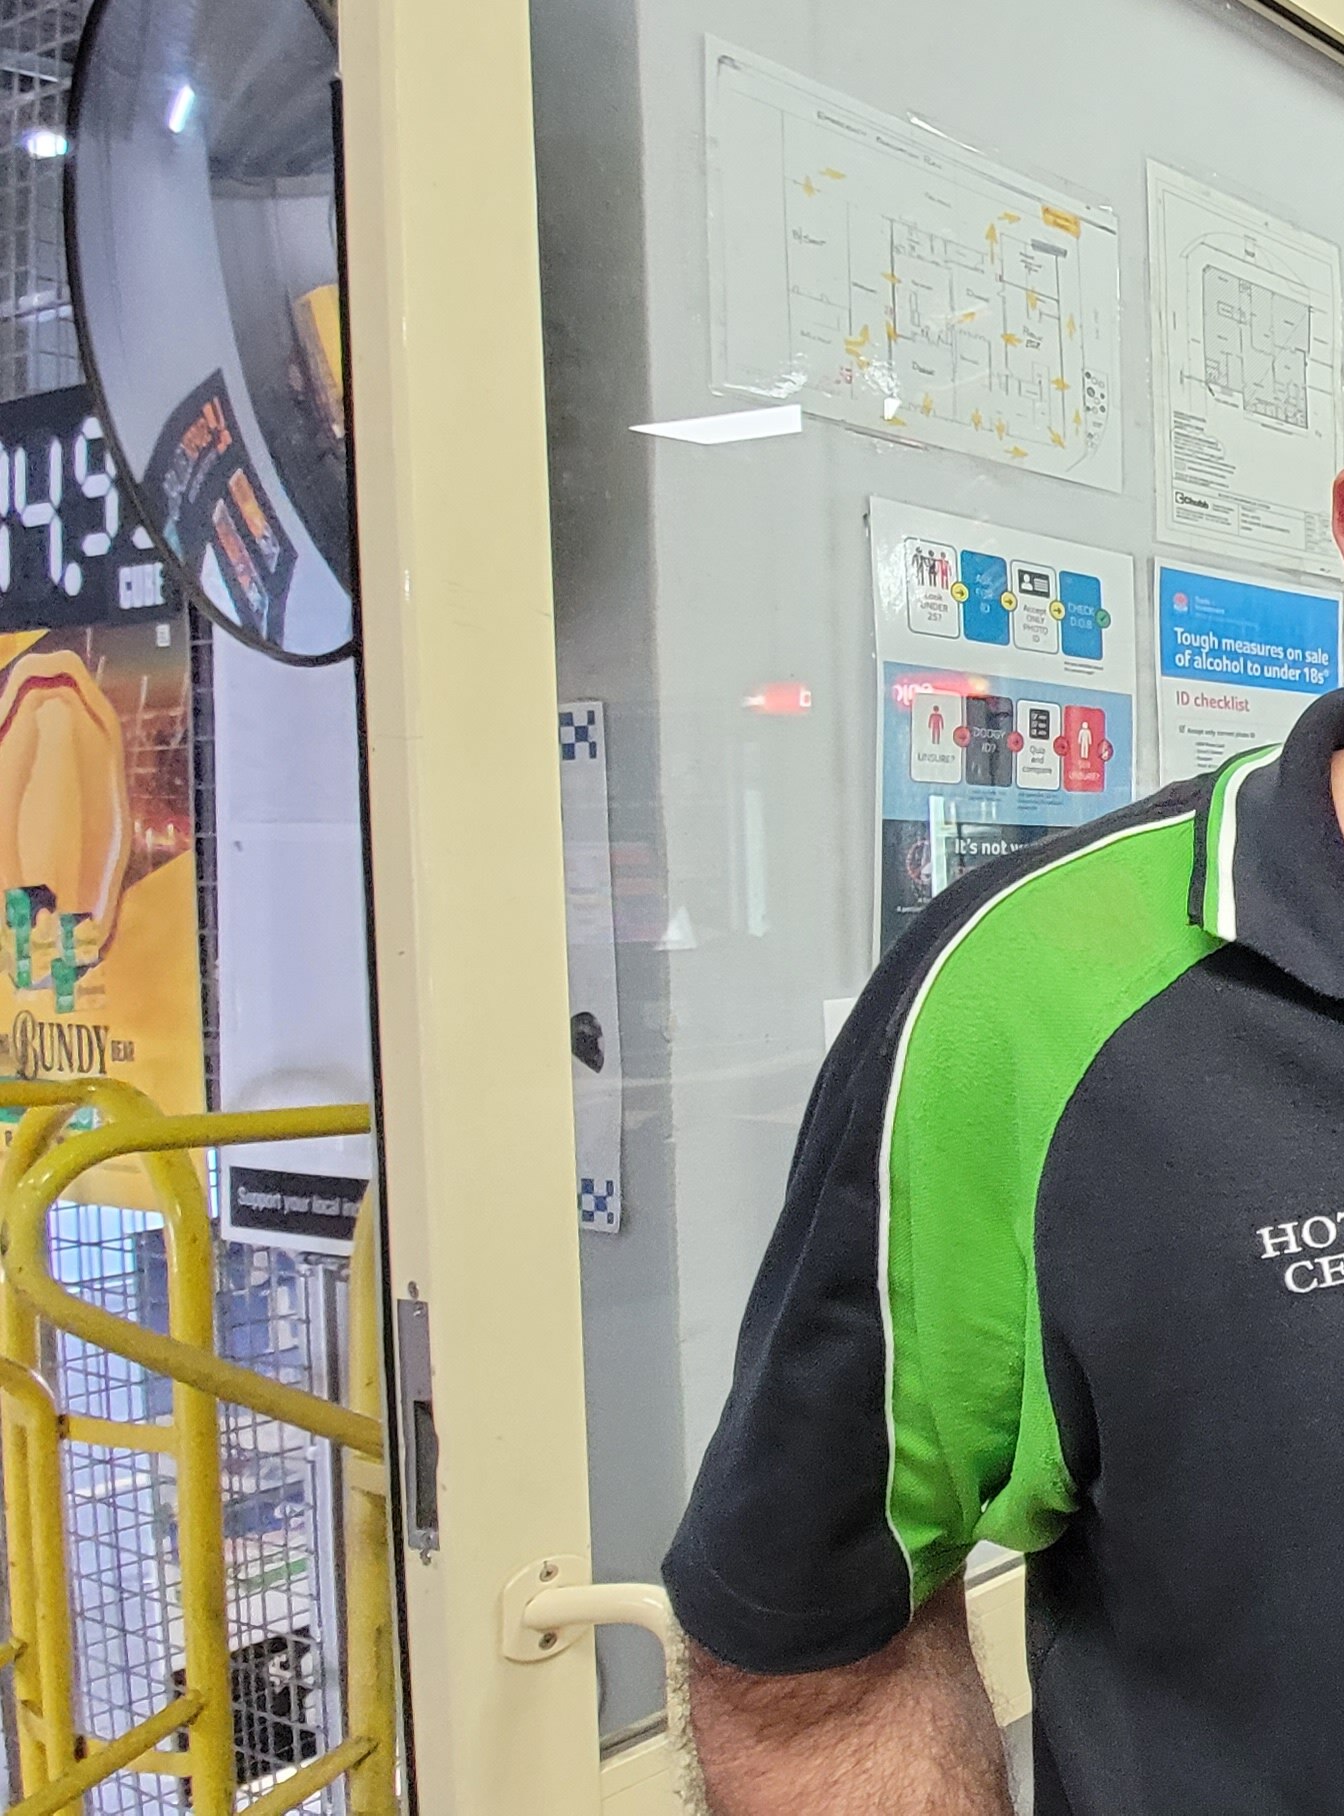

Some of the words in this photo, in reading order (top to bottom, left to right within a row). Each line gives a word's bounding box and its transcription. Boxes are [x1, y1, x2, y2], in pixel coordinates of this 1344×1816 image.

[1174, 626, 1219, 651] Tough
[1221, 637, 1285, 660] measures
[1286, 648, 1303, 662] on
[1305, 647, 1329, 666] sale
[1174, 650, 1192, 668] of
[1193, 652, 1245, 675] alcohol
[1246, 660, 1261, 677] to
[1263, 661, 1301, 682] under
[1175, 690, 1190, 706] ID
[1193, 692, 1251, 713] checklist
[954, 838, 979, 855] It's
[981, 839, 1008, 856] not
[12, 1008, 110, 1082] BUNDY
